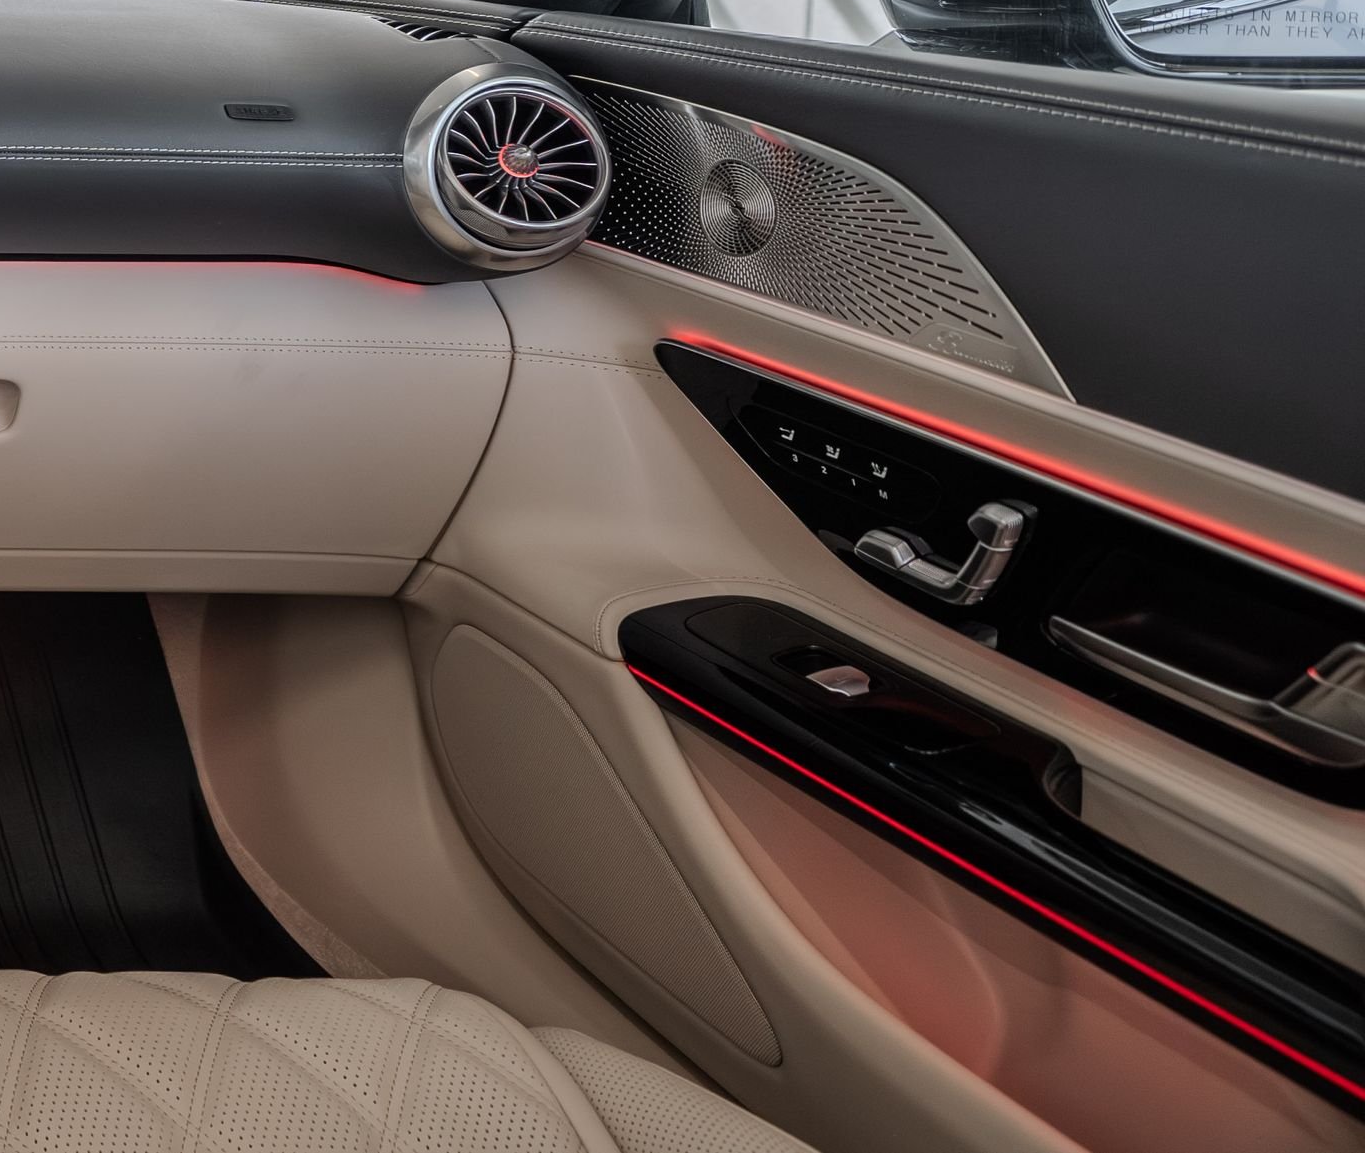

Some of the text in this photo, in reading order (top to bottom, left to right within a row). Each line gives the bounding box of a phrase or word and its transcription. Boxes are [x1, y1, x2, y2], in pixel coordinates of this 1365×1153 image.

[1151, 8, 1359, 24] OBJECTS IN MIRROR
[1139, 23, 1210, 36] CLOSER
[1225, 24, 1271, 37] THAN
[1285, 25, 1333, 39] THEY
[792, 453, 889, 501] 3 2 1 M
